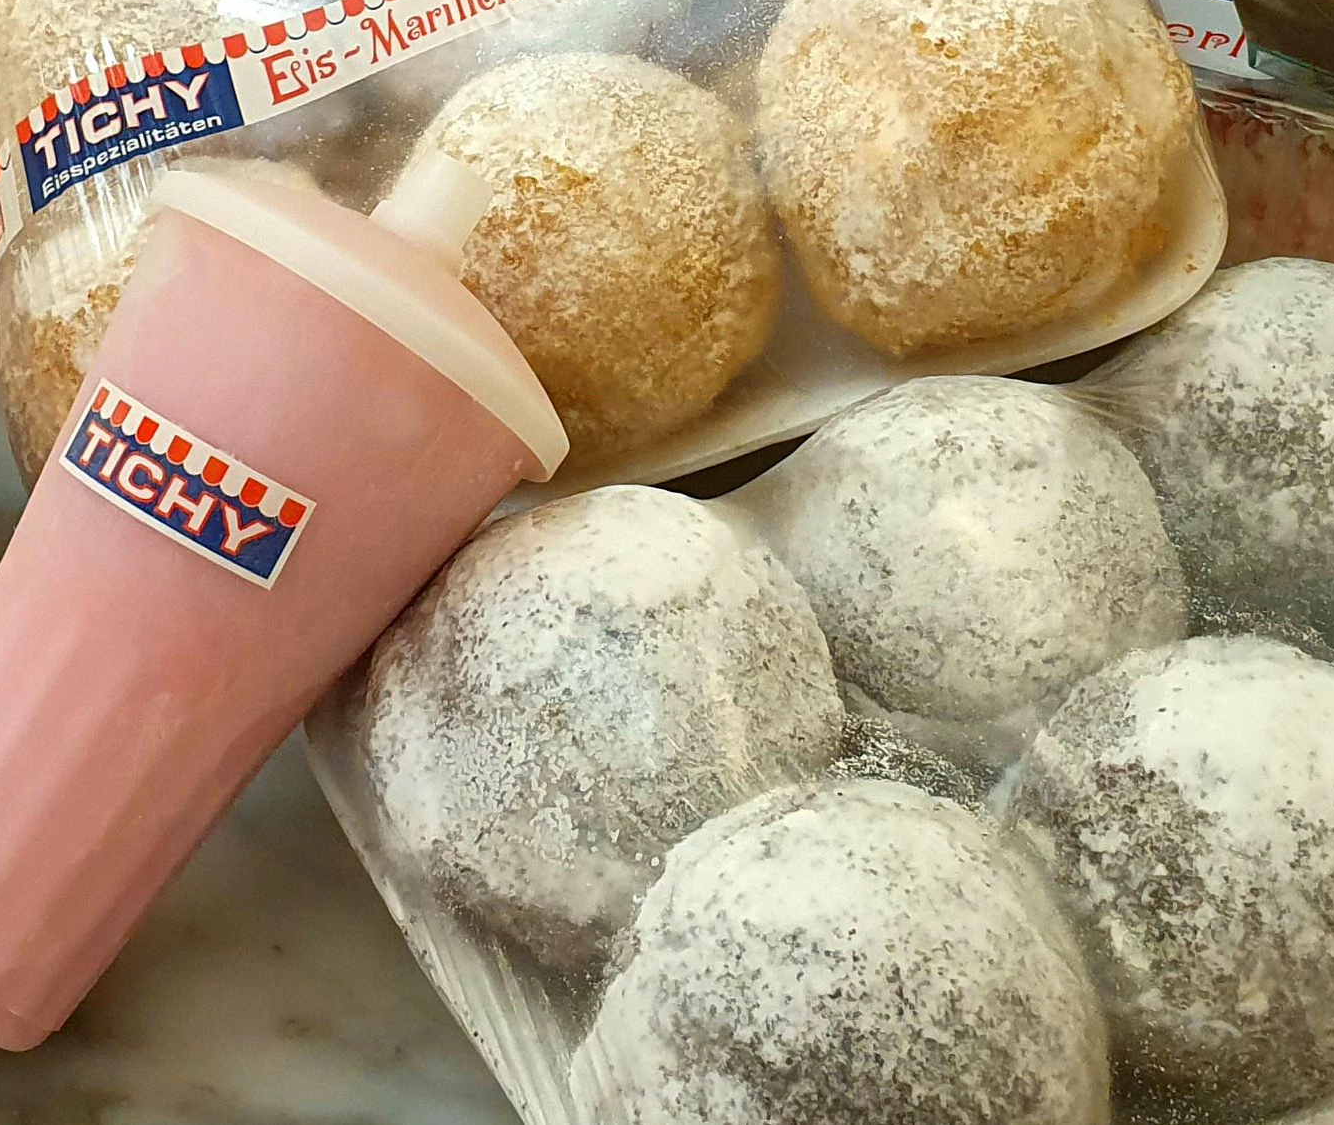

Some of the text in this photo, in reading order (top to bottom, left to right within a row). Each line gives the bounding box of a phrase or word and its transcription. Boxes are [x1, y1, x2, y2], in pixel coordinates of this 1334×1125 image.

[32, 71, 210, 170] TICHY
[42, 111, 223, 200] Eisspezialitäten
[79, 419, 275, 556] TICHY
